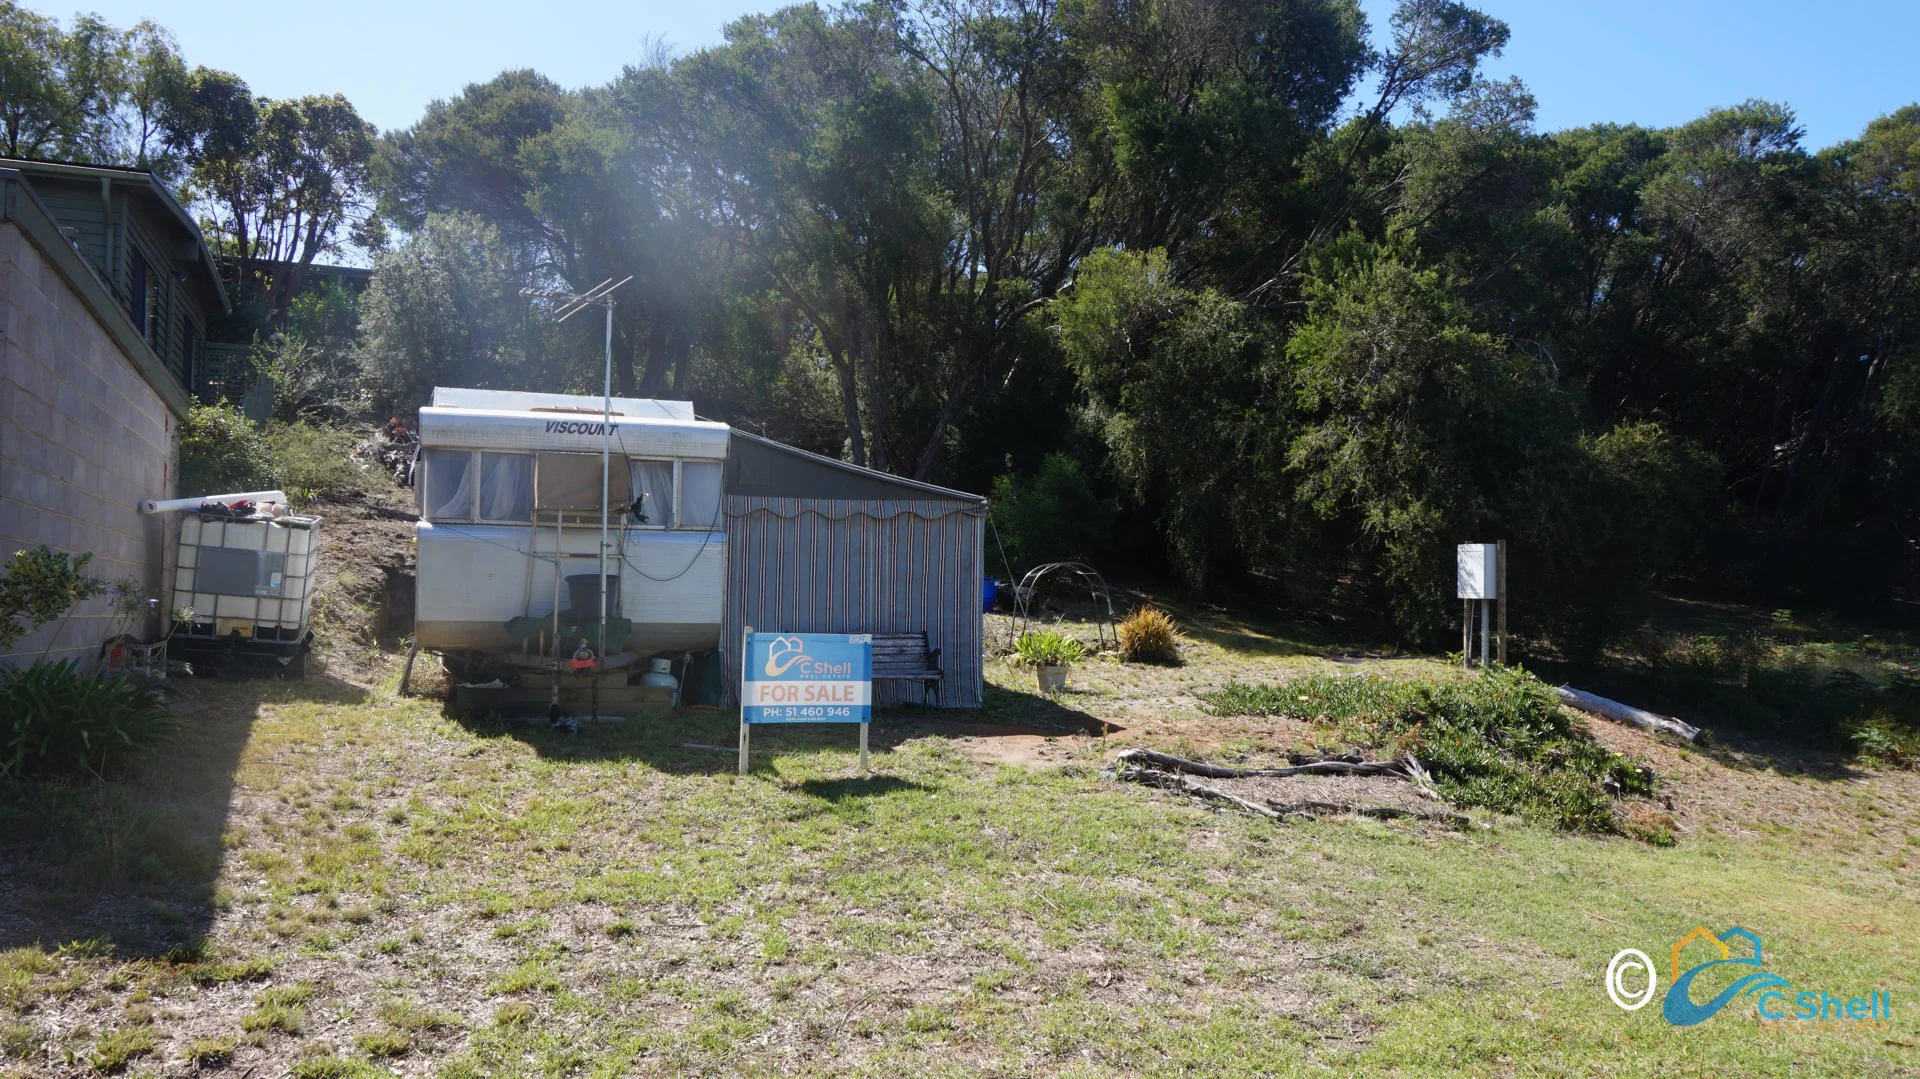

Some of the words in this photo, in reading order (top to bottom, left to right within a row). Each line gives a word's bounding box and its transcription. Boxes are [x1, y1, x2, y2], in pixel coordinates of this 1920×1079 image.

[545, 421, 619, 436] VISCOUNT
[800, 661, 811, 674] C
[814, 661, 851, 674] Shell
[760, 685, 799, 702] FOR
[804, 685, 855, 702] SALE
[763, 707, 782, 717] PH:
[785, 707, 797, 717] 51
[800, 707, 824, 717] 460
[827, 707, 850, 717] 946
